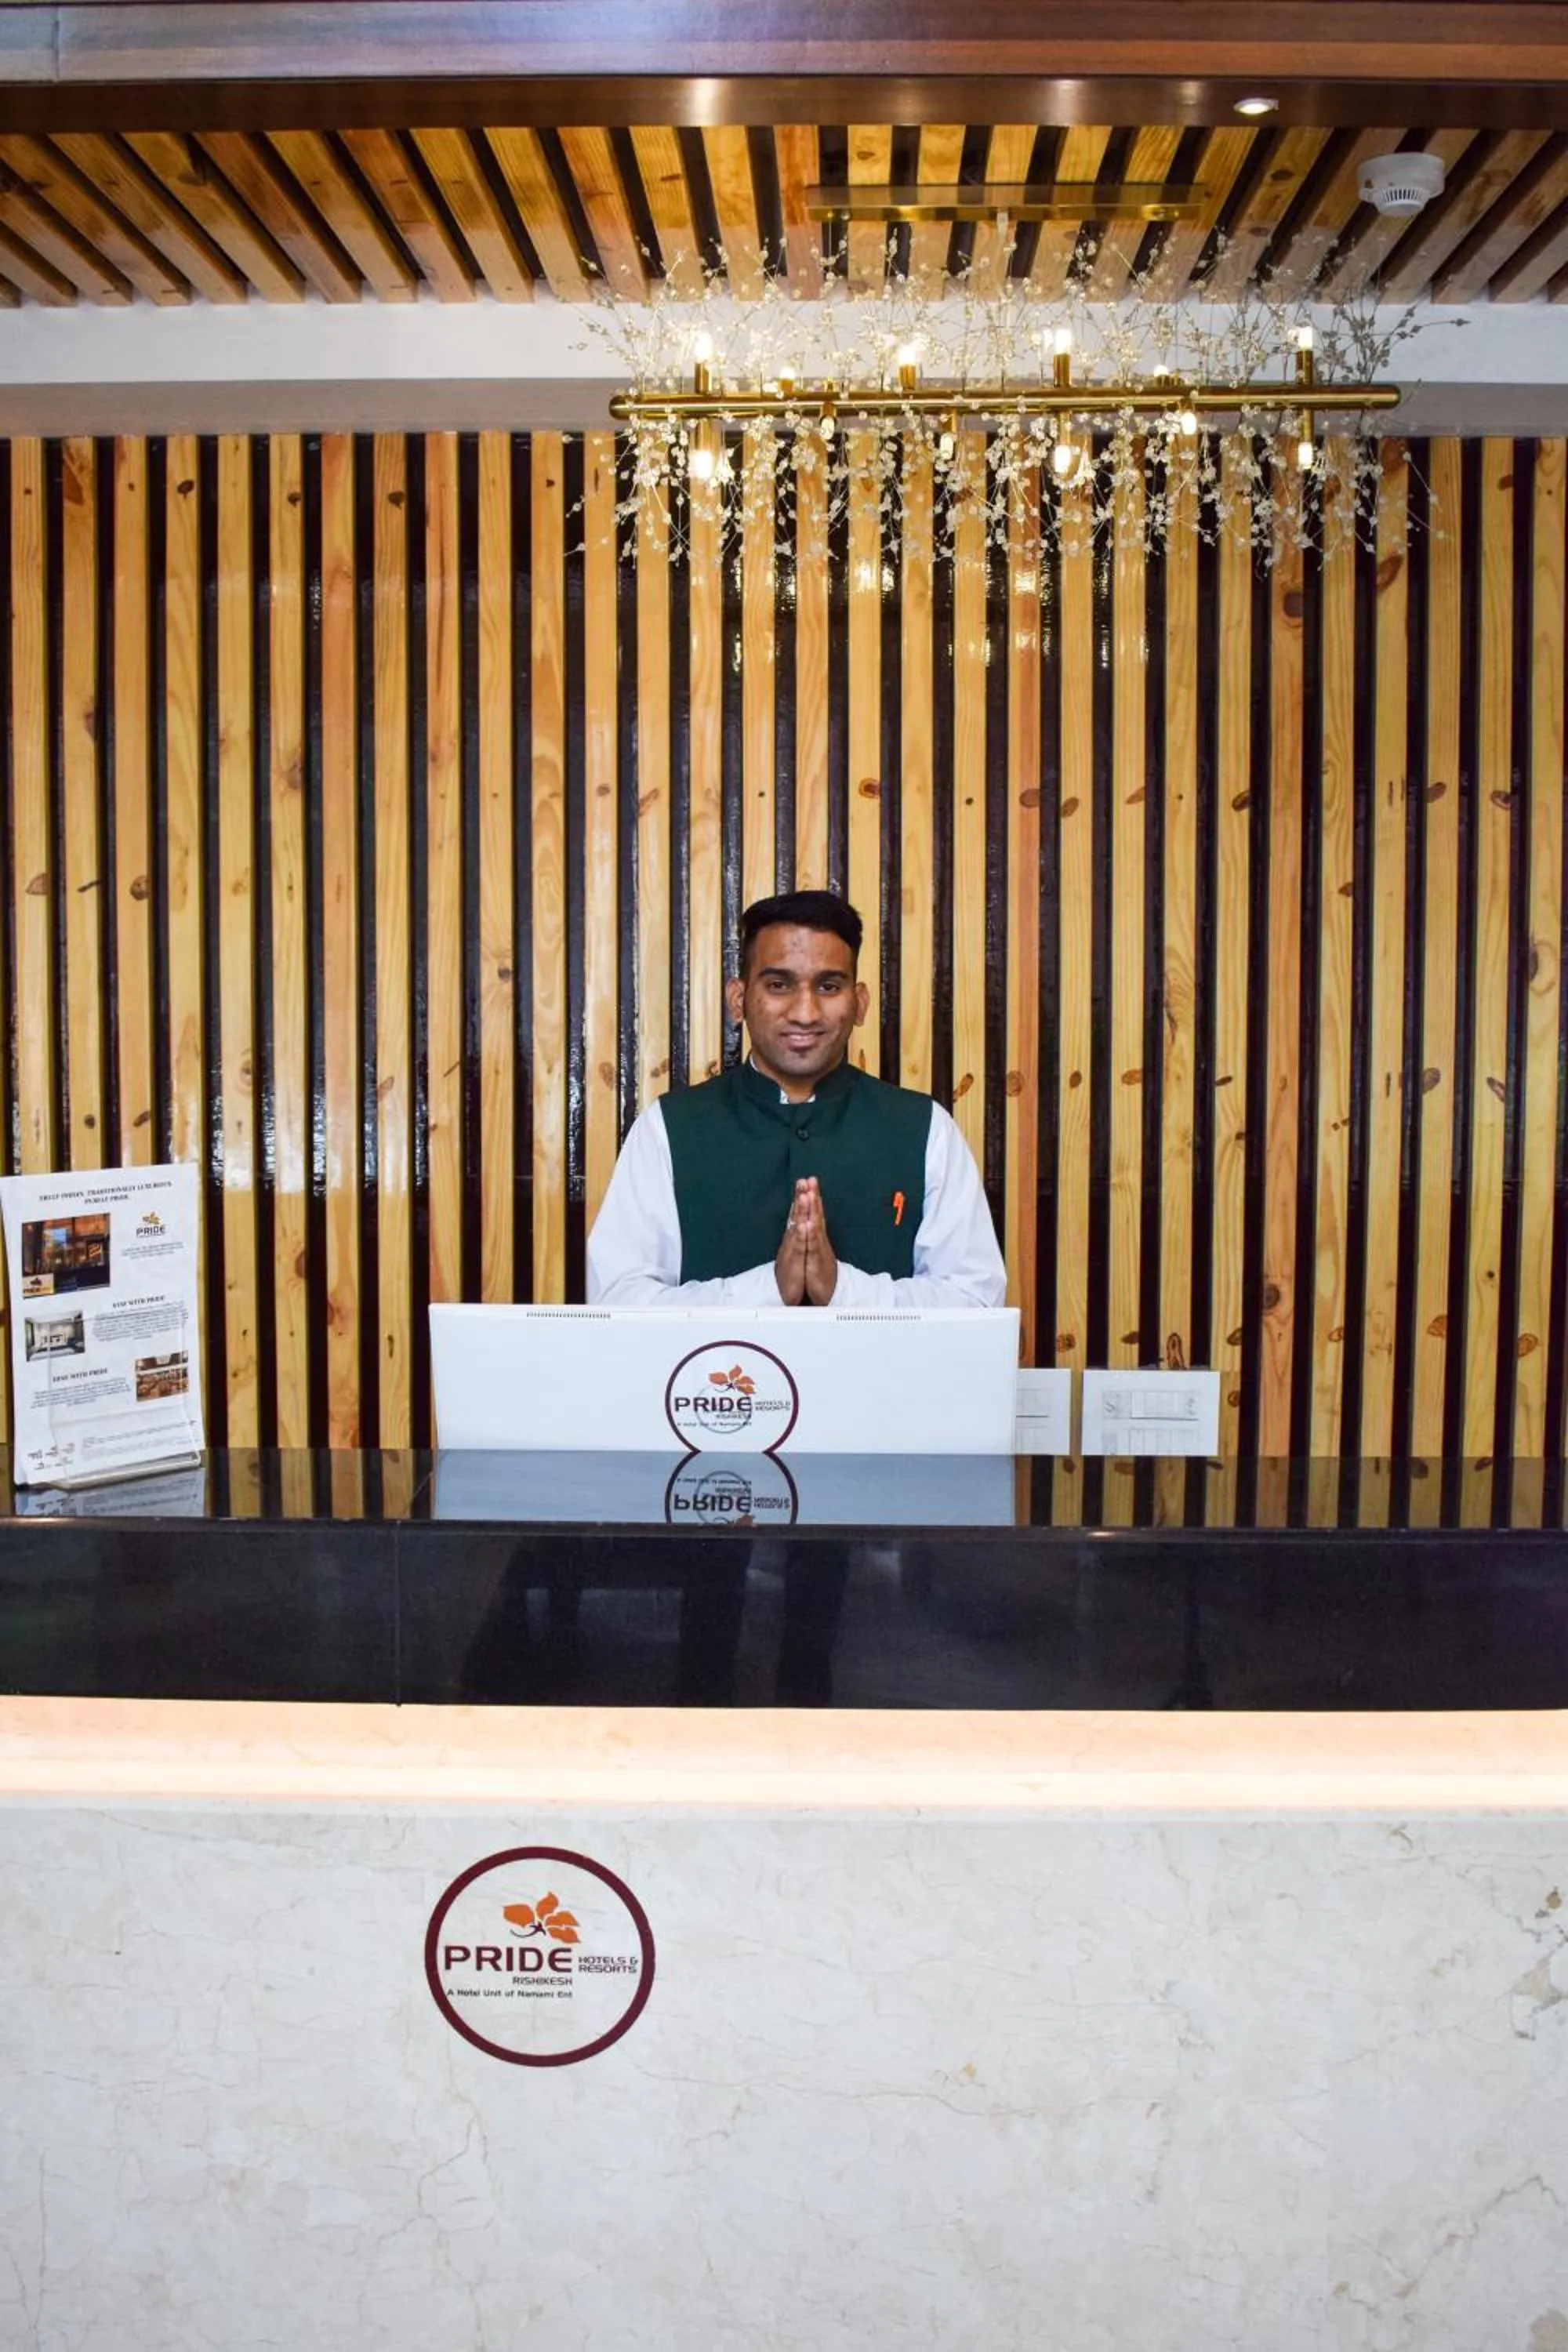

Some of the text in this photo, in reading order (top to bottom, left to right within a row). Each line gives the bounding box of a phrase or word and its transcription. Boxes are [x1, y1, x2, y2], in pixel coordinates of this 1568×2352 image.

[136, 1225, 165, 1236] PRIDE
[674, 1396, 752, 1412] PRIDE
[444, 1945, 573, 1973] PRIDE
[579, 1956, 638, 1965] HOTELS &
[578, 1965, 637, 1973] RESORTS
[512, 1976, 573, 1986] RISHIKESH
[447, 1988, 455, 1997] A
[456, 1988, 481, 1997] Hotel
[483, 1989, 502, 1998] Unit
[504, 1989, 514, 1998] of
[517, 1990, 554, 1998] Namami
